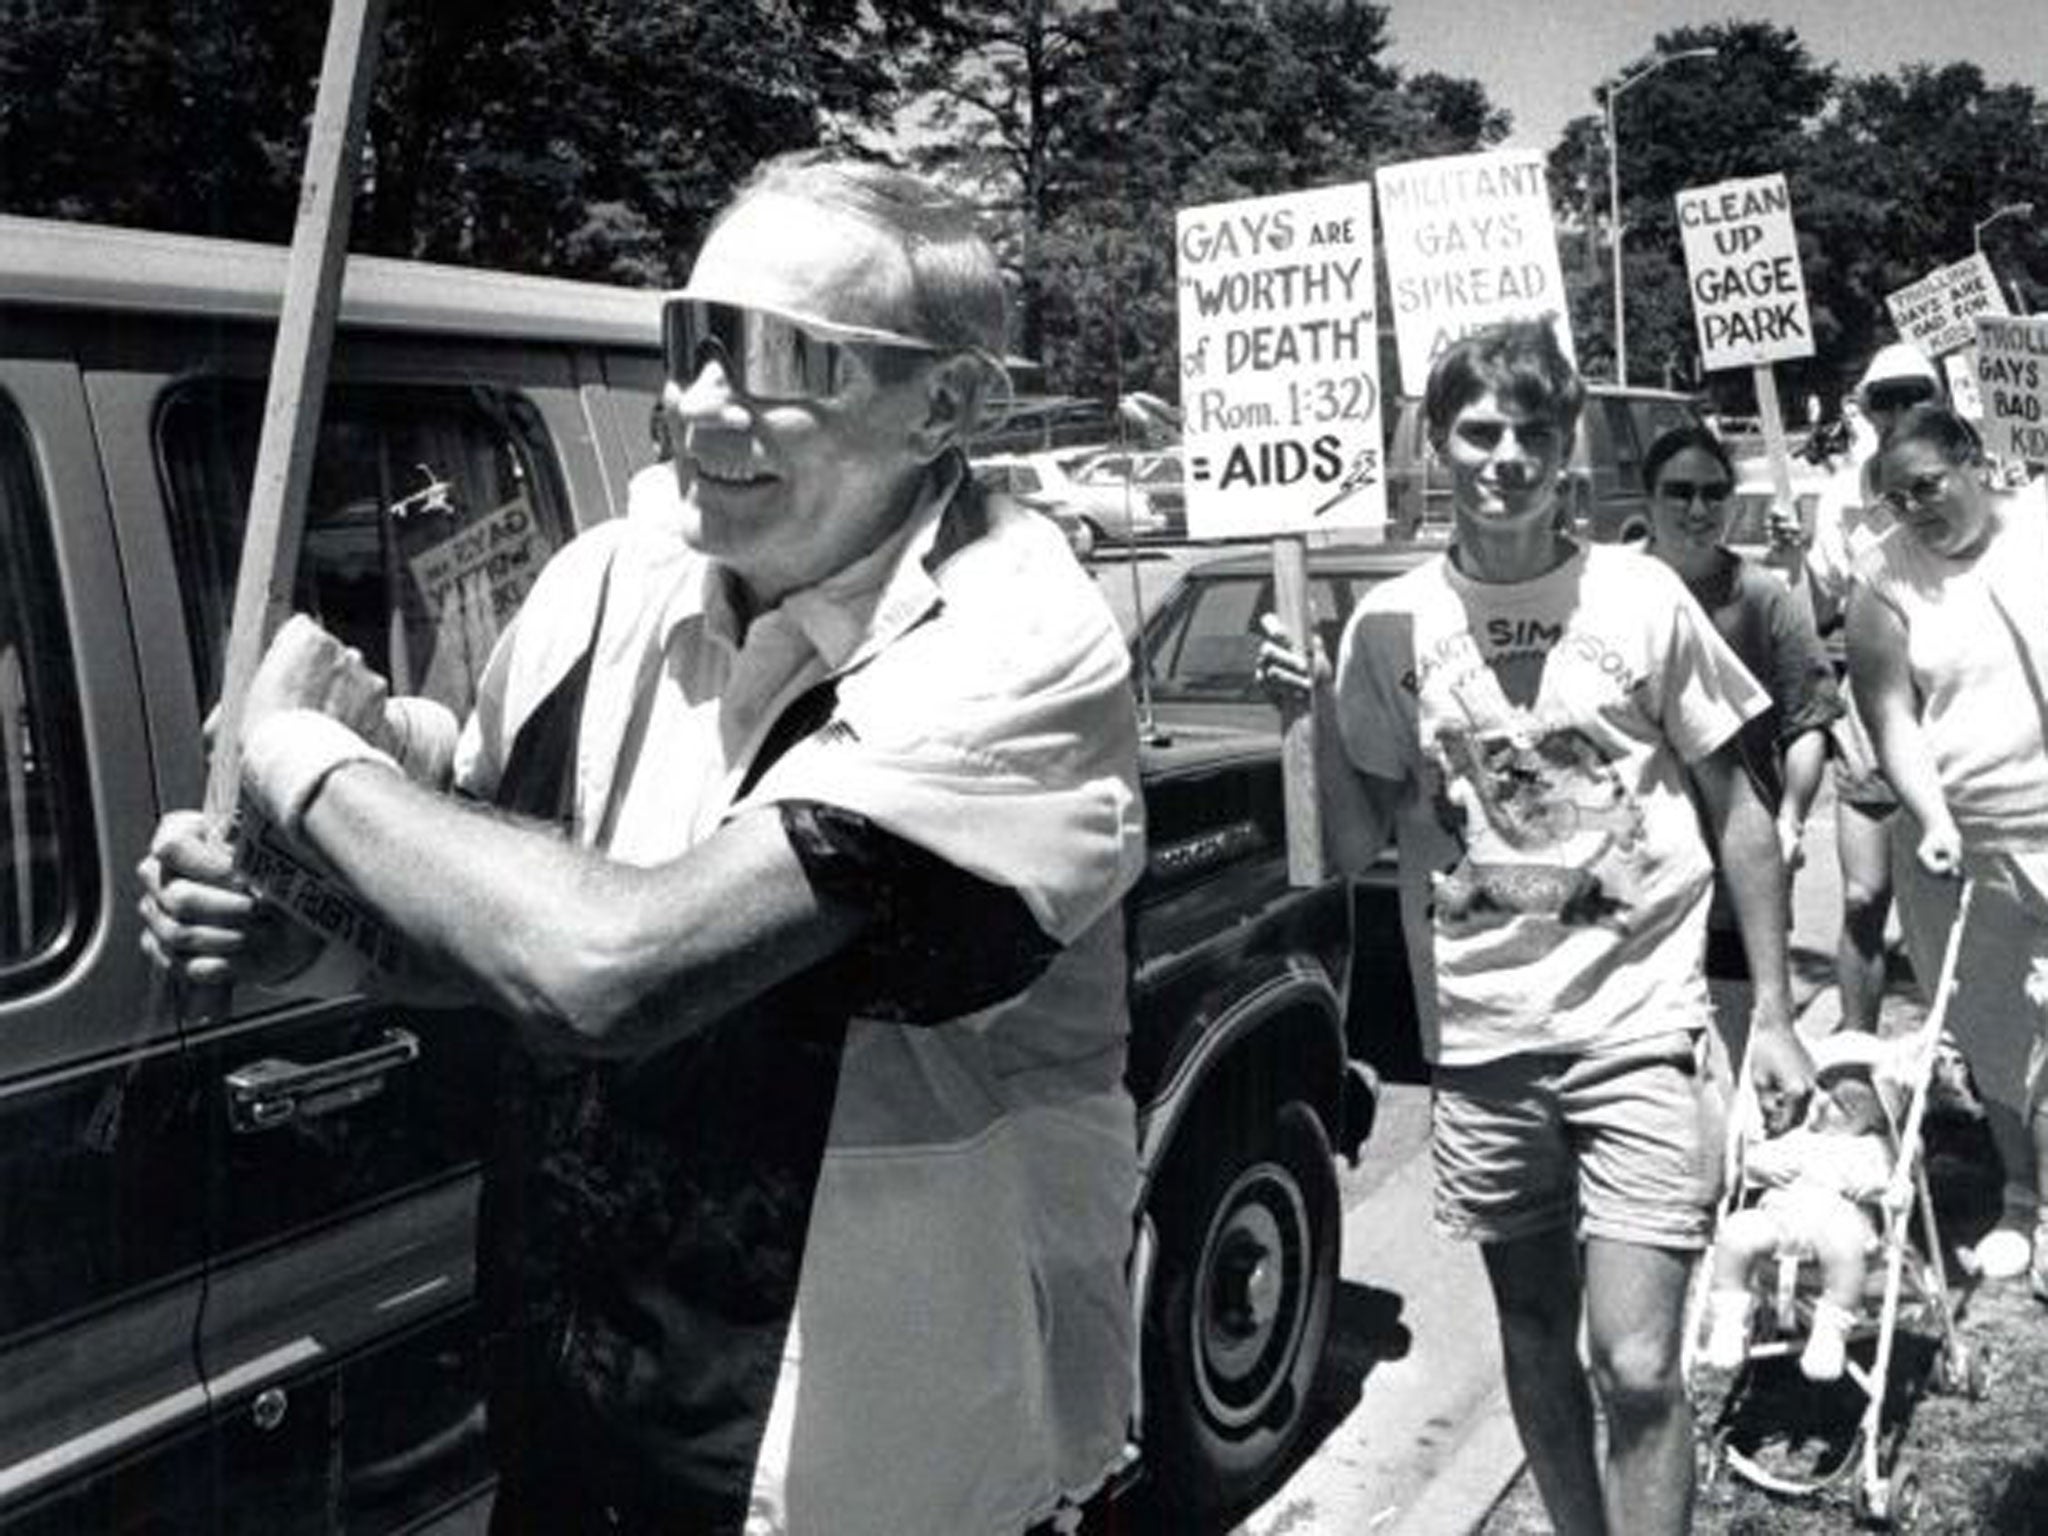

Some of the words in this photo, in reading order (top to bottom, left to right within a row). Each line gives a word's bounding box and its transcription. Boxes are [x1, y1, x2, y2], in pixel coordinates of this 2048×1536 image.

[1382, 163, 1542, 209] MILITANT
[1680, 185, 1786, 228] CLEAN
[1181, 210, 1295, 264] GAYS
[1308, 217, 1355, 246] ARE
[1415, 212, 1523, 259] GAYS
[1714, 224, 1763, 255] UP
[1181, 258, 1363, 316] "WORTHY
[1396, 262, 1547, 313] SPREAD
[1695, 256, 1797, 305] GAGE
[1184, 337, 1208, 377] of
[1226, 309, 1374, 374] DEATH"
[1703, 303, 1804, 349] PARK
[1978, 357, 2039, 390] GAYS
[1288, 373, 1376, 426] 1:32)
[1994, 390, 2041, 423] BAD
